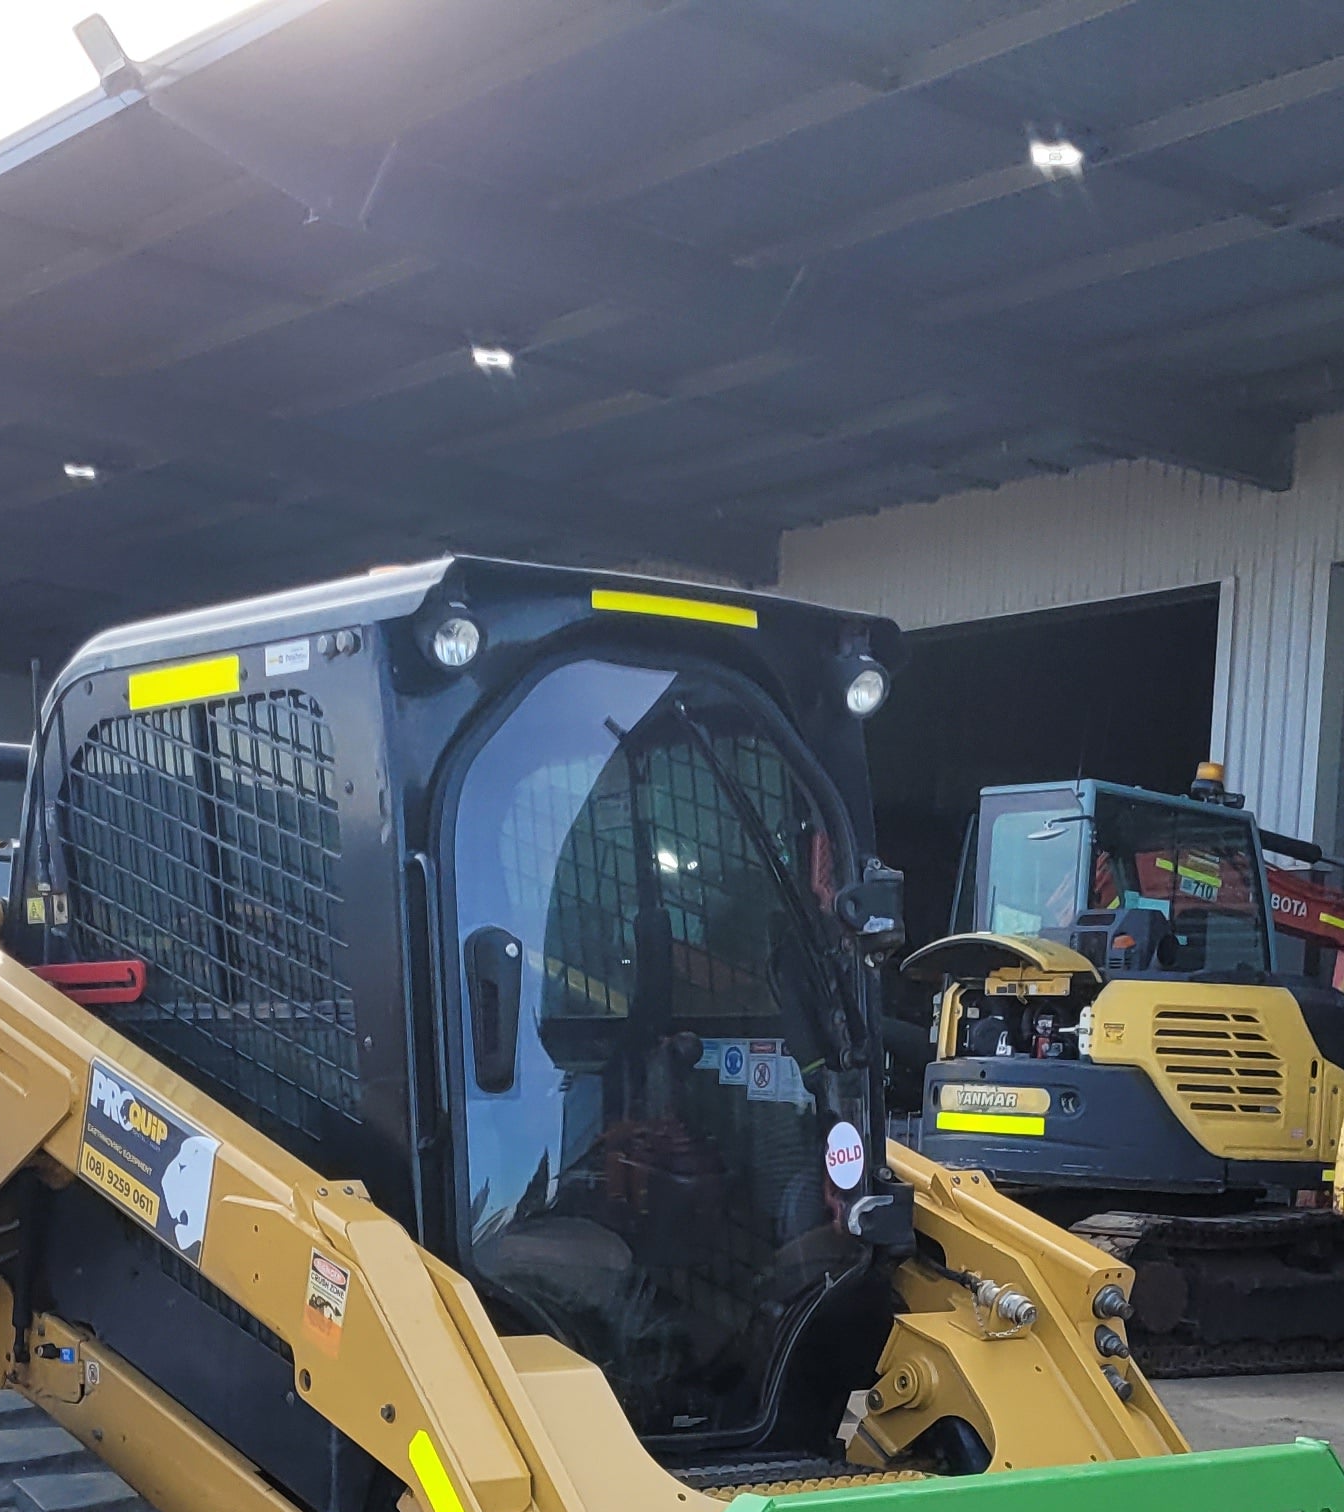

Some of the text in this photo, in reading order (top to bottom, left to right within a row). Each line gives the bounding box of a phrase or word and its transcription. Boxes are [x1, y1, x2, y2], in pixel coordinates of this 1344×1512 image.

[1270, 893, 1308, 917] BOTA
[956, 1090, 1019, 1107] YANMAR
[827, 1144, 862, 1167] SOLD
[85, 1151, 154, 1216] (08) 9259 0611
